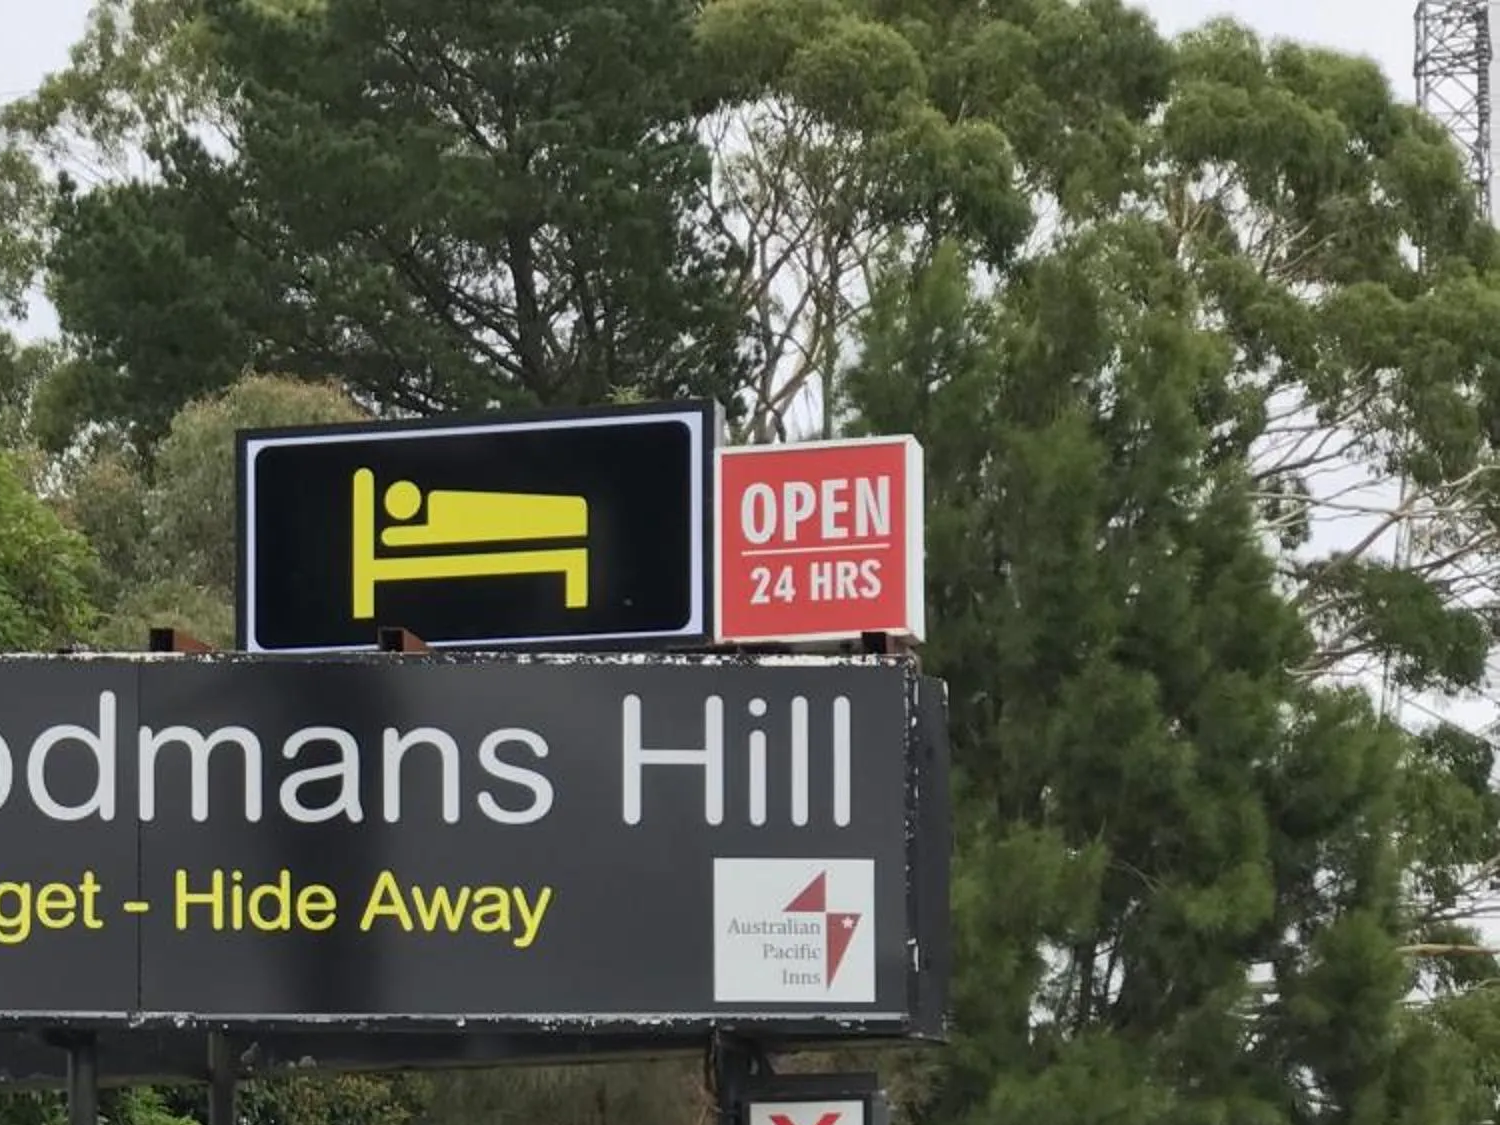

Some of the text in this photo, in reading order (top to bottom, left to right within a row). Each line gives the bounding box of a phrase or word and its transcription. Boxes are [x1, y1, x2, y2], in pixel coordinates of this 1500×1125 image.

[741, 475, 891, 544] OPEN
[750, 558, 882, 605] 24 HRS
[622, 694, 852, 827] Hill
[175, 869, 337, 931] Hide
[360, 870, 553, 948] Away
[727, 918, 821, 936] Australian
[762, 944, 821, 960] Pacific
[782, 969, 821, 985] Inns
